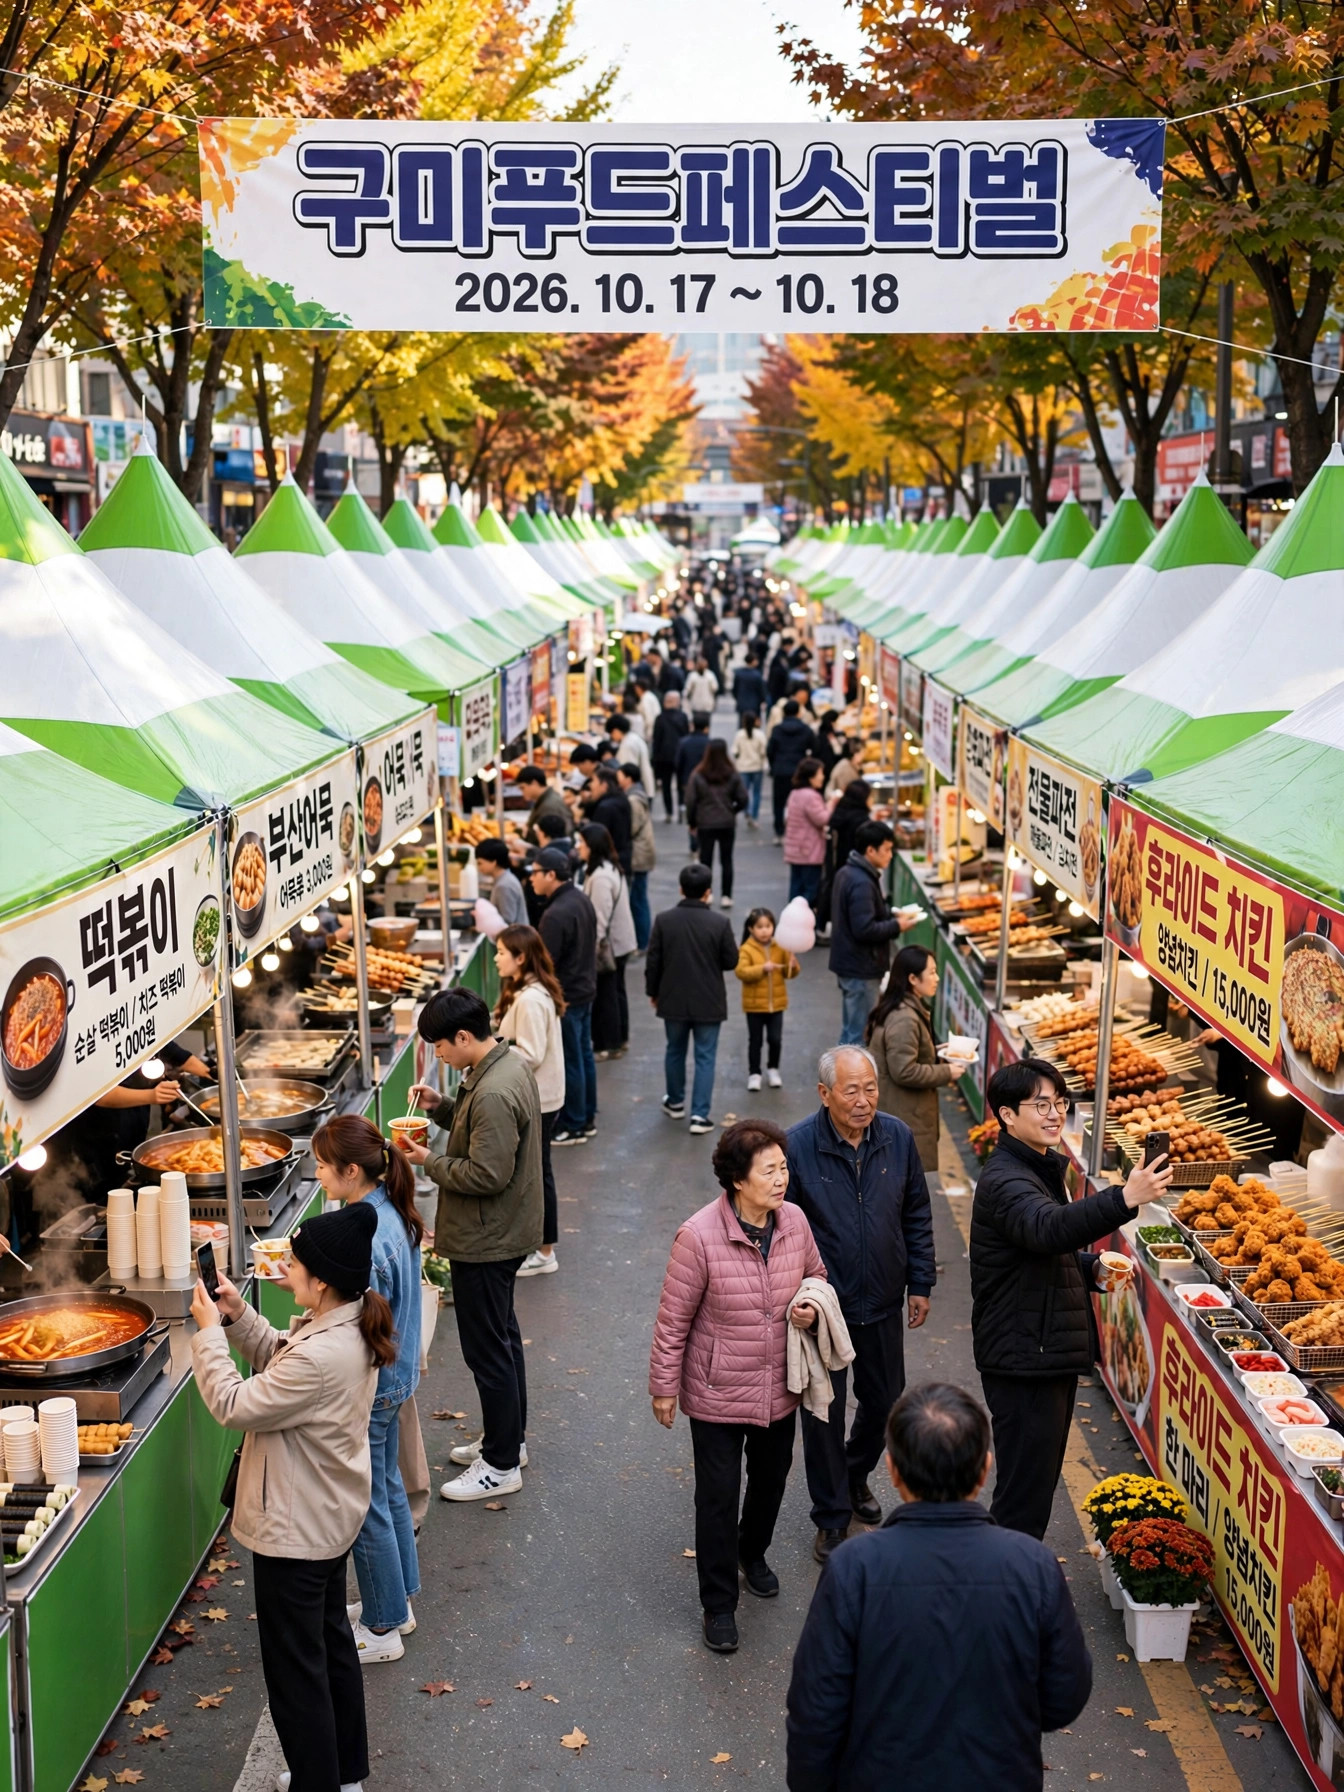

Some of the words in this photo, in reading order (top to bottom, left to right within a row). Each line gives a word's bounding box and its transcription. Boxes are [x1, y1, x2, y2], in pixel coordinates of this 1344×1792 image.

[293, 139, 1067, 259] 구미푸드페스티벌
[455, 272, 580, 313] 2026.
[595, 273, 654, 313] 10.
[669, 273, 717, 314] 17
[730, 286, 762, 301] ~
[776, 273, 835, 314] 10.
[851, 273, 899, 314] 18
[268, 781, 334, 874] 부산어묵
[1028, 765, 1077, 843] 전물파전
[79, 866, 179, 995] 떡볶이
[1146, 838, 1219, 945] 후라이드
[1225, 885, 1273, 985] 치킨
[115, 1015, 156, 1068] 5,000원
[132, 995, 137, 1024] /
[139, 984, 158, 1015] 치즈
[1158, 922, 1199, 992] 양념치킨
[1202, 958, 1209, 997] /
[1213, 967, 1271, 1048] 15,000원
[1163, 1335, 1233, 1495] 후라이드
[1237, 1444, 1281, 1572] 치킨
[1165, 1415, 1179, 1479] 한
[1182, 1448, 1210, 1531] 마리
[1223, 1506, 1277, 1630] 양념치킨
[1225, 1566, 1276, 1681] 15,000원
